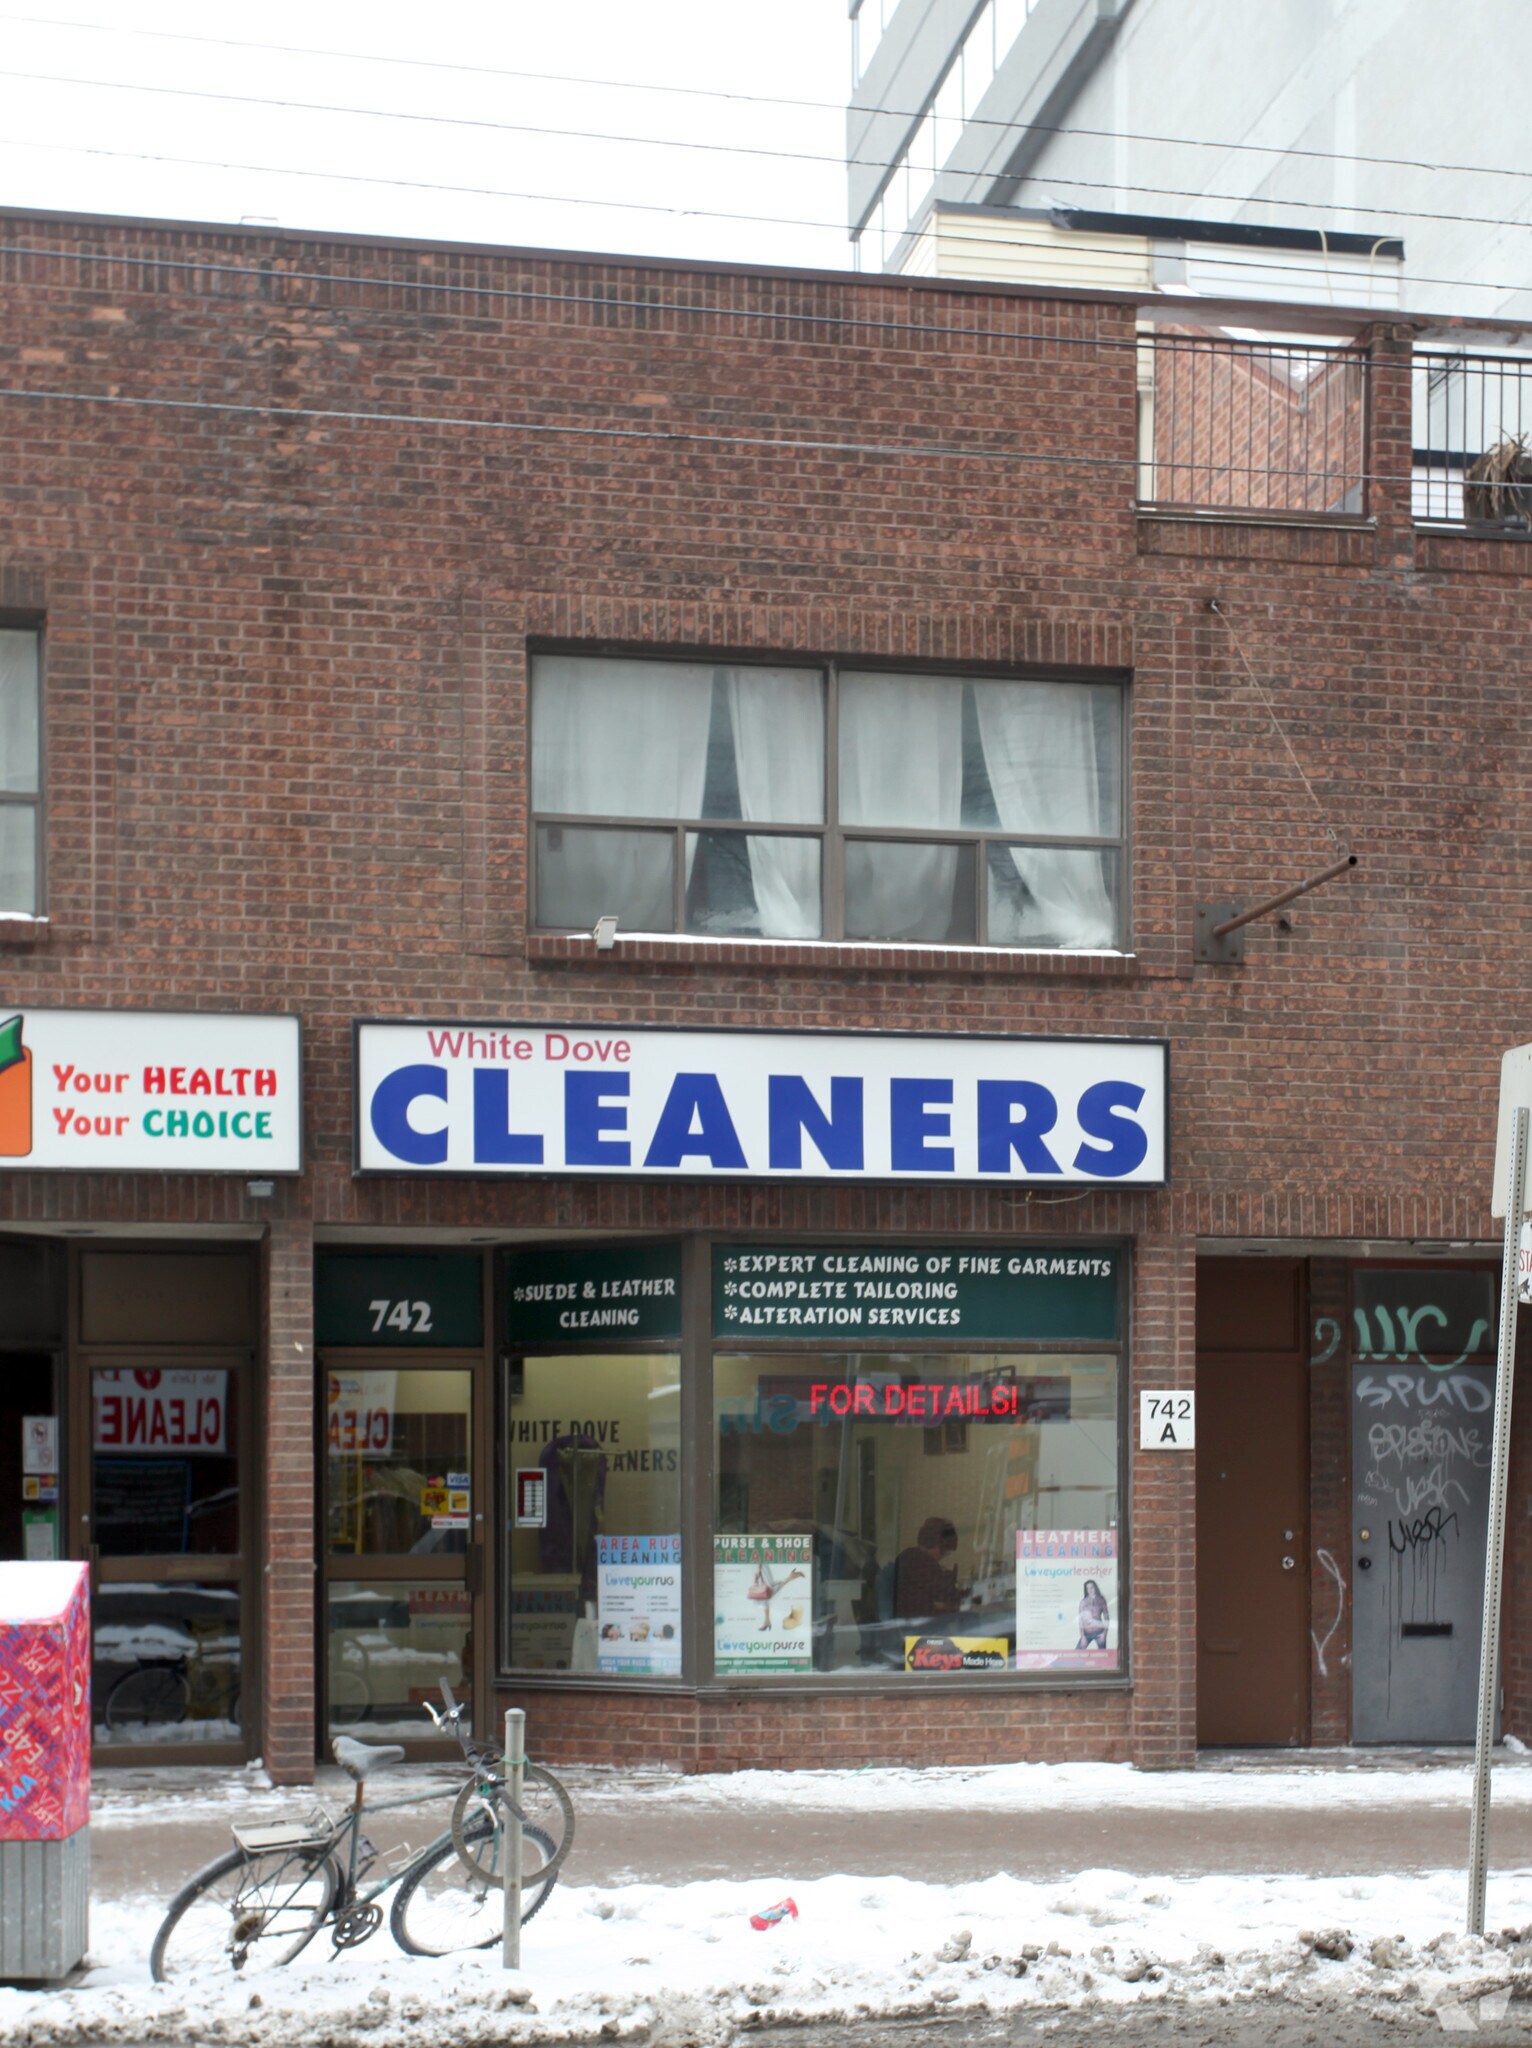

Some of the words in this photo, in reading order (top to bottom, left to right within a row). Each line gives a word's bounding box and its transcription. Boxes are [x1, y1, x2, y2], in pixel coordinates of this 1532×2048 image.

[428, 1032, 533, 1060] White
[545, 1034, 631, 1063] Dove
[54, 1065, 129, 1093] Your
[143, 1066, 277, 1097] HEALTH
[54, 1108, 130, 1136] Your
[142, 1110, 272, 1138] CHOICE
[370, 1064, 1148, 1177] CLEANERS
[739, 1255, 816, 1273] EXPERT
[823, 1256, 919, 1274] CLEANING
[926, 1256, 952, 1274] OF
[959, 1257, 1001, 1274] FINE
[1008, 1258, 1111, 1277] GARMENTS
[525, 1284, 577, 1301] SUEDE
[582, 1281, 596, 1299] &
[601, 1278, 676, 1298] LEATHER
[739, 1281, 847, 1299] COMPLETE
[854, 1282, 958, 1300] TAILORING
[368, 1300, 433, 1332] 742
[559, 1308, 640, 1328] CLEANING
[739, 1307, 862, 1325] ALTERATION
[868, 1308, 961, 1326] SERVICES
[811, 1384, 876, 1416] FOR
[885, 1384, 1019, 1416] DETAILS!
[1148, 1398, 1191, 1420] 742
[1160, 1423, 1177, 1443] A
[600, 1538, 640, 1551] AREA
[649, 1537, 681, 1551] RUG
[714, 1538, 755, 1548] PURSE
[761, 1538, 770, 1548] &
[776, 1538, 810, 1548] SHOE
[1023, 1531, 1112, 1543] LEATHER
[600, 1552, 682, 1564] CLEANING
[714, 1550, 811, 1562] CLEANING
[1023, 1546, 1113, 1557] CLEANING
[914, 1649, 963, 1671] Keys
[963, 1656, 985, 1666] Made
[2, 1728, 45, 1764] E4P
